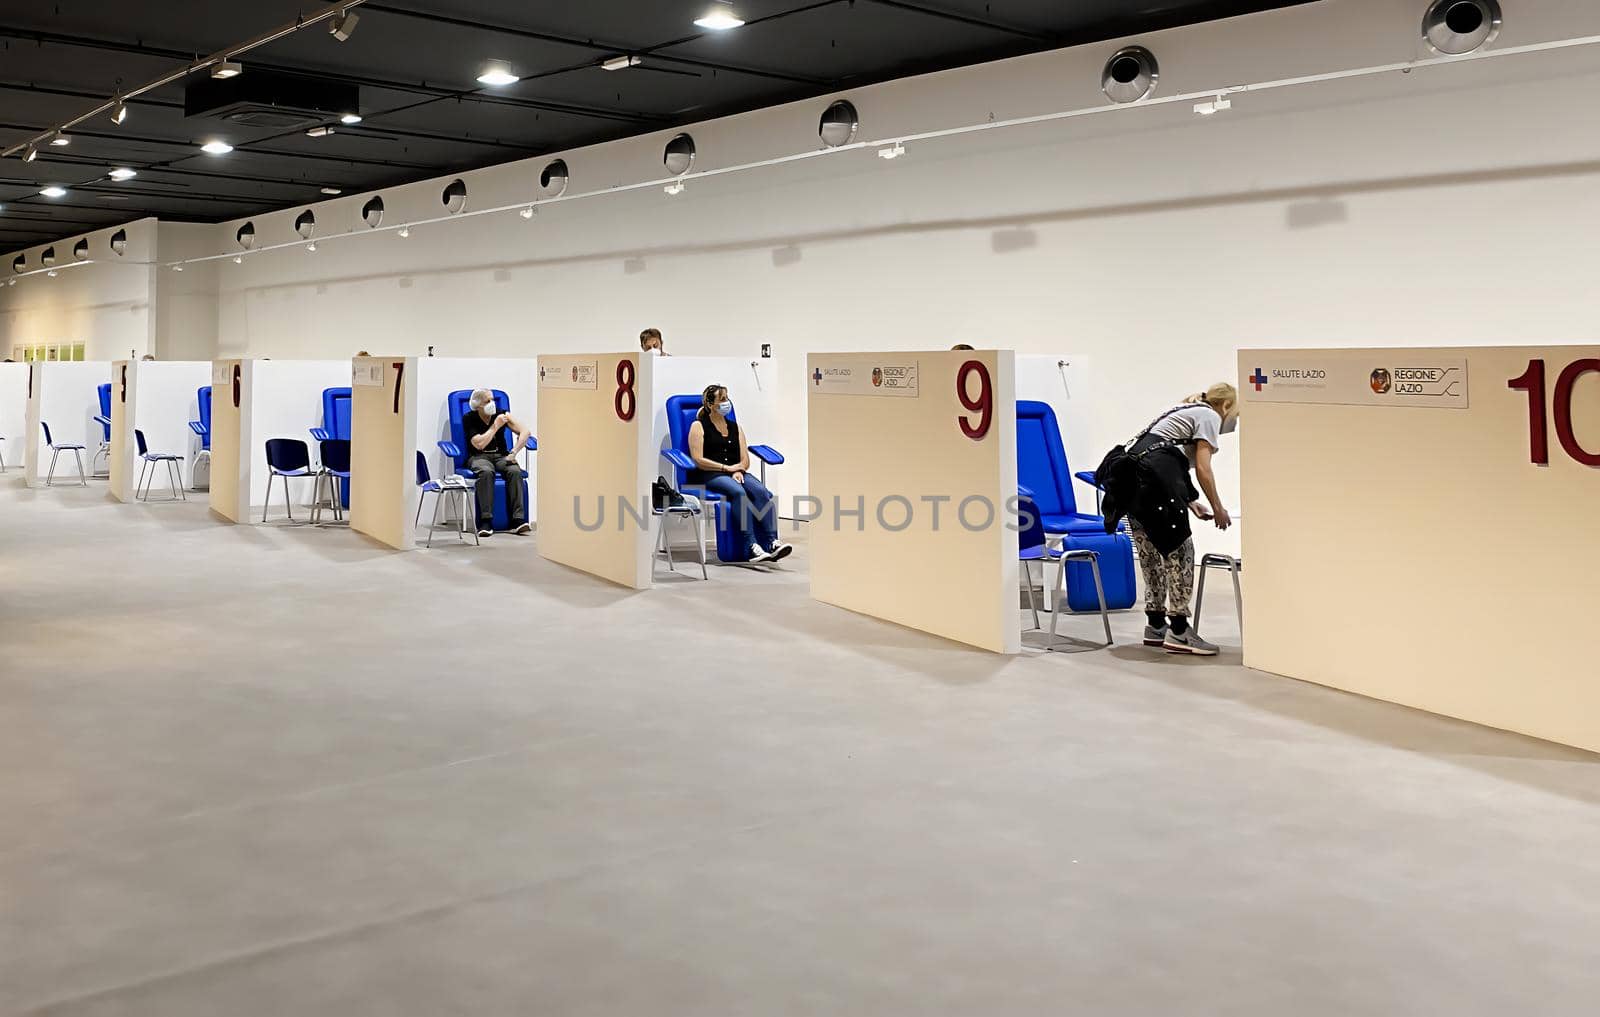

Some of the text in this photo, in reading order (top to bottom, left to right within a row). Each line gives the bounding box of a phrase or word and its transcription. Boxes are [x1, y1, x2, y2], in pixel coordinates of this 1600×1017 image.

[392, 362, 404, 413] 7
[615, 359, 636, 421] 8
[956, 360, 993, 439] 9
[1272, 369, 1326, 379] SALUTE LAZIO
[1394, 370, 1437, 380] REGIONE
[1394, 383, 1423, 393] LAZIO
[1507, 358, 1600, 466] 10
